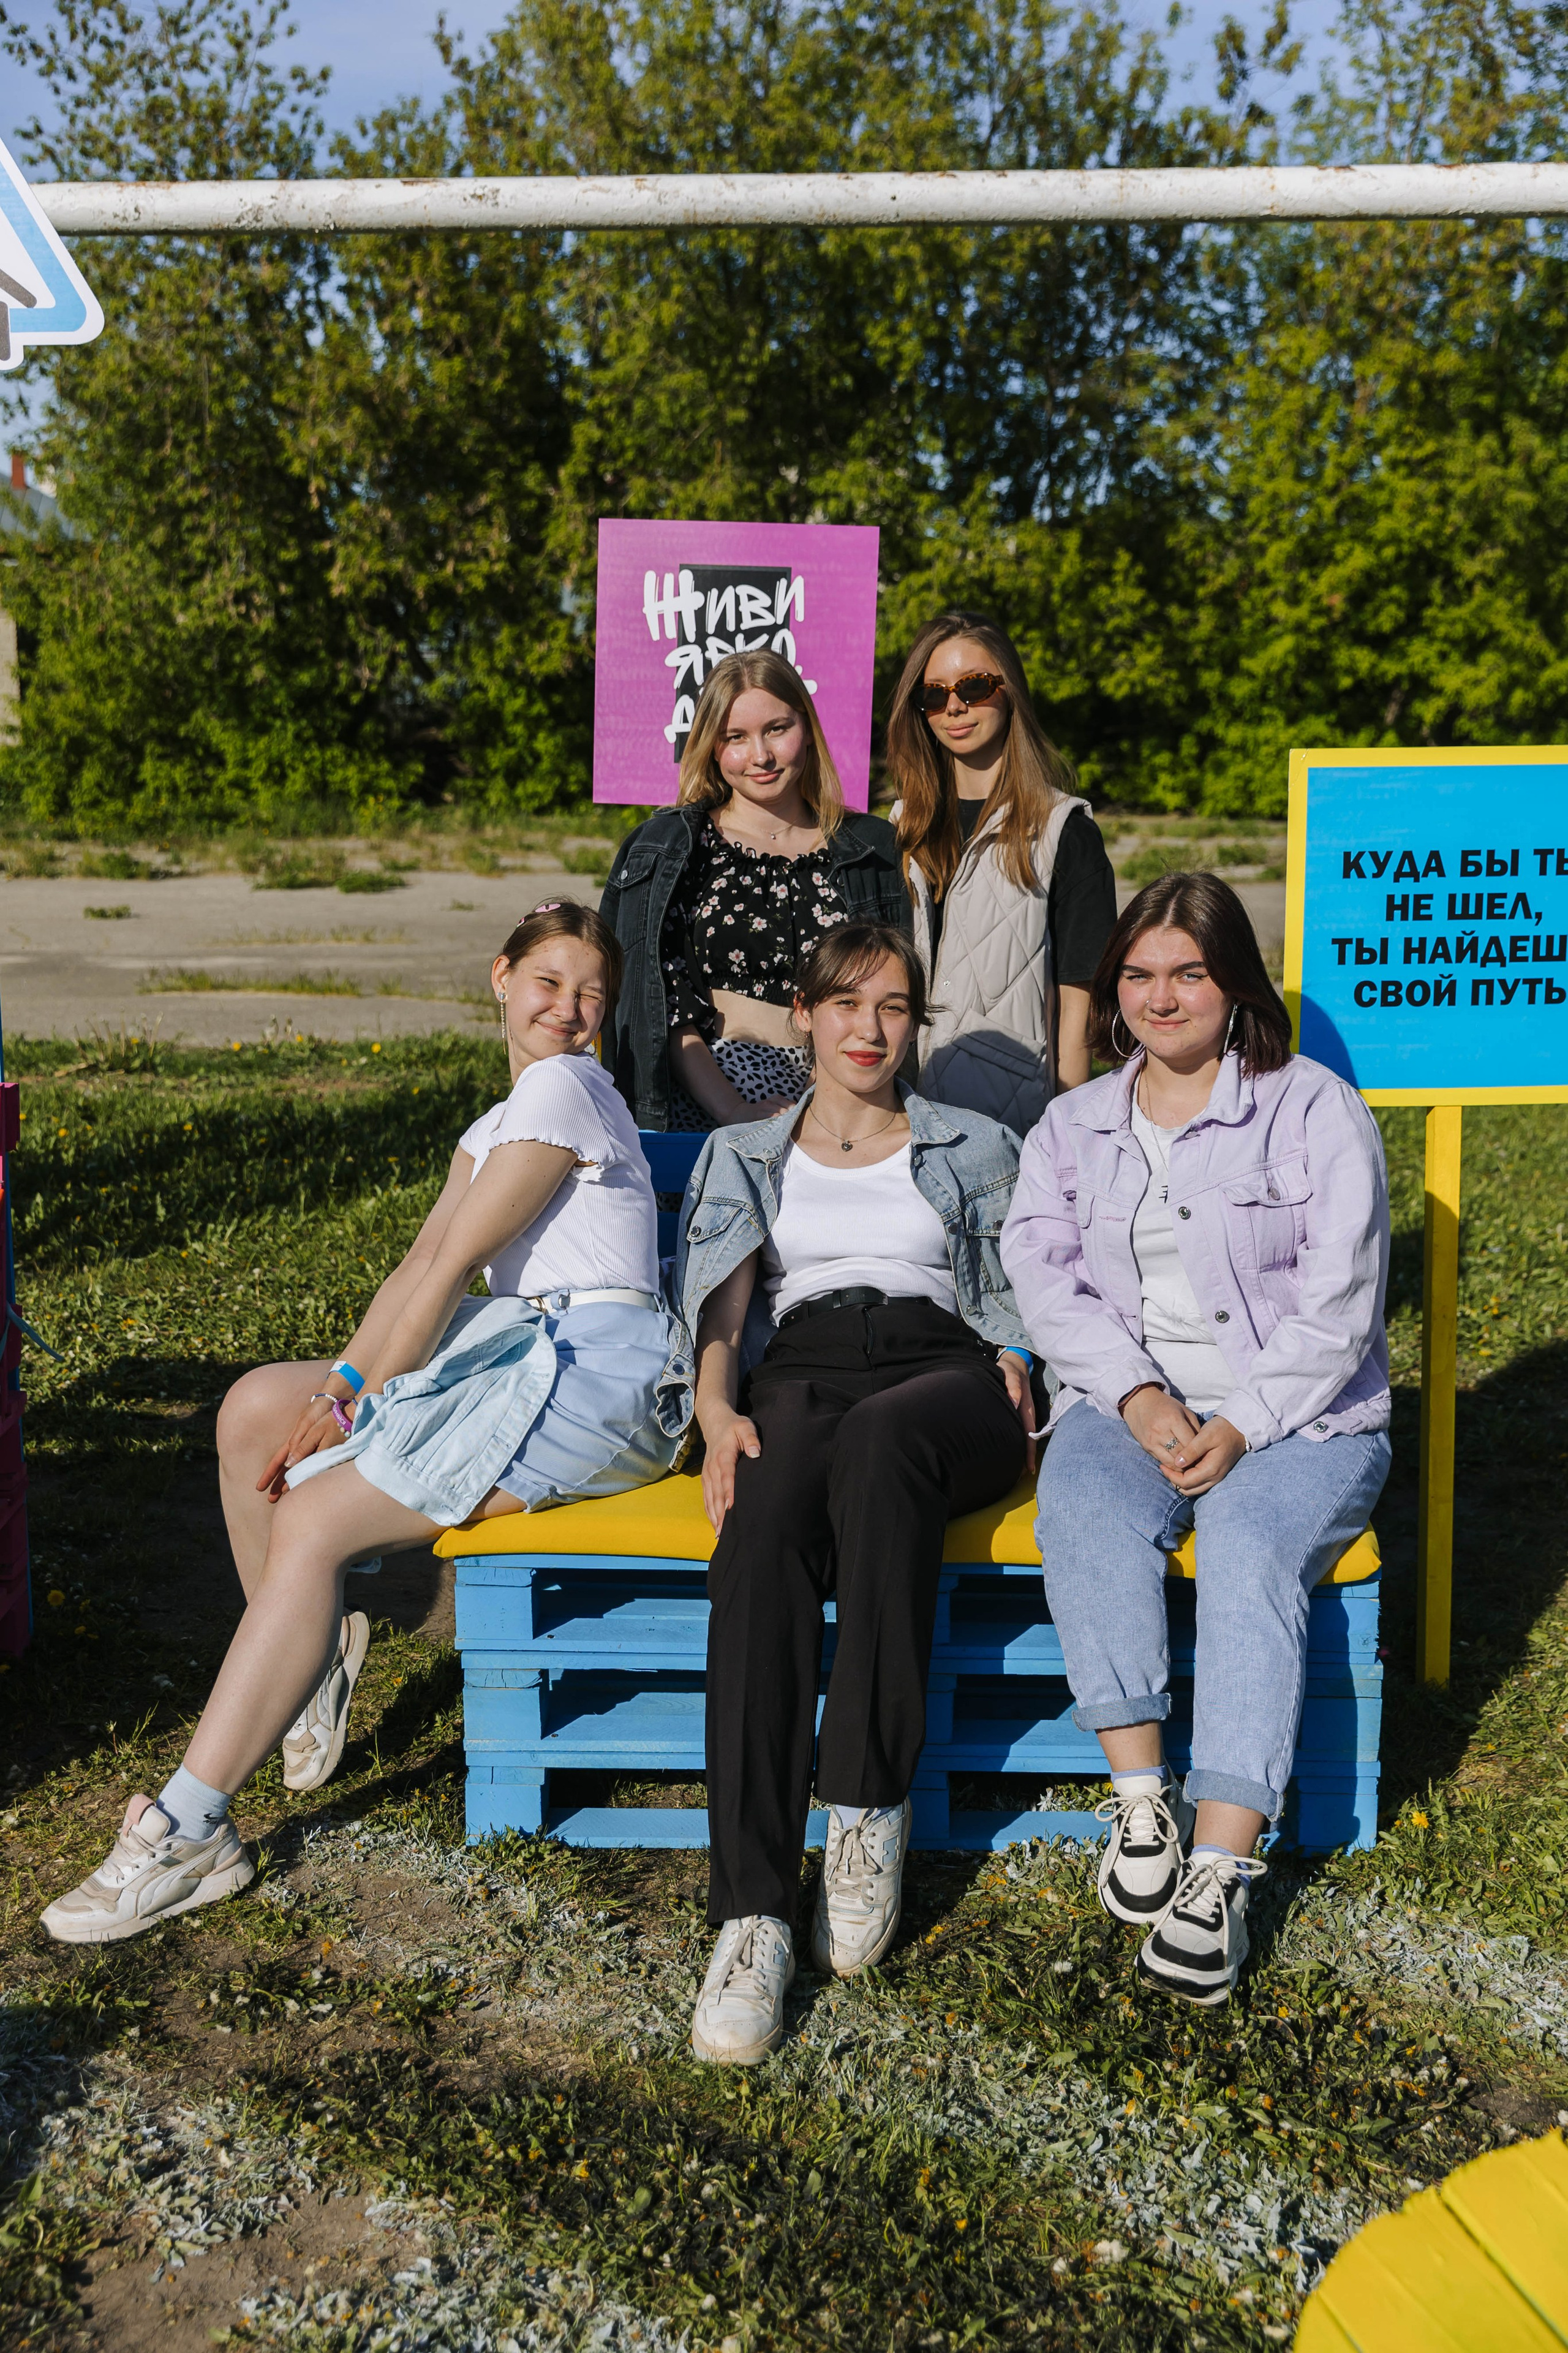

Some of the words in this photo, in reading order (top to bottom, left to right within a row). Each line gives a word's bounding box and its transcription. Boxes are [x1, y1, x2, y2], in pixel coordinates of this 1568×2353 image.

[643, 569, 804, 642] ЖИВИ
[1343, 850, 1446, 883] КУДА
[1460, 849, 1520, 877] БЫ
[1385, 894, 1433, 921] НЕ
[1447, 892, 1543, 926] ШЕЛ,
[1331, 937, 1389, 965] ТЫ
[1354, 974, 1457, 1008] СВОЙ
[1471, 978, 1567, 1007] ПУТЬ
